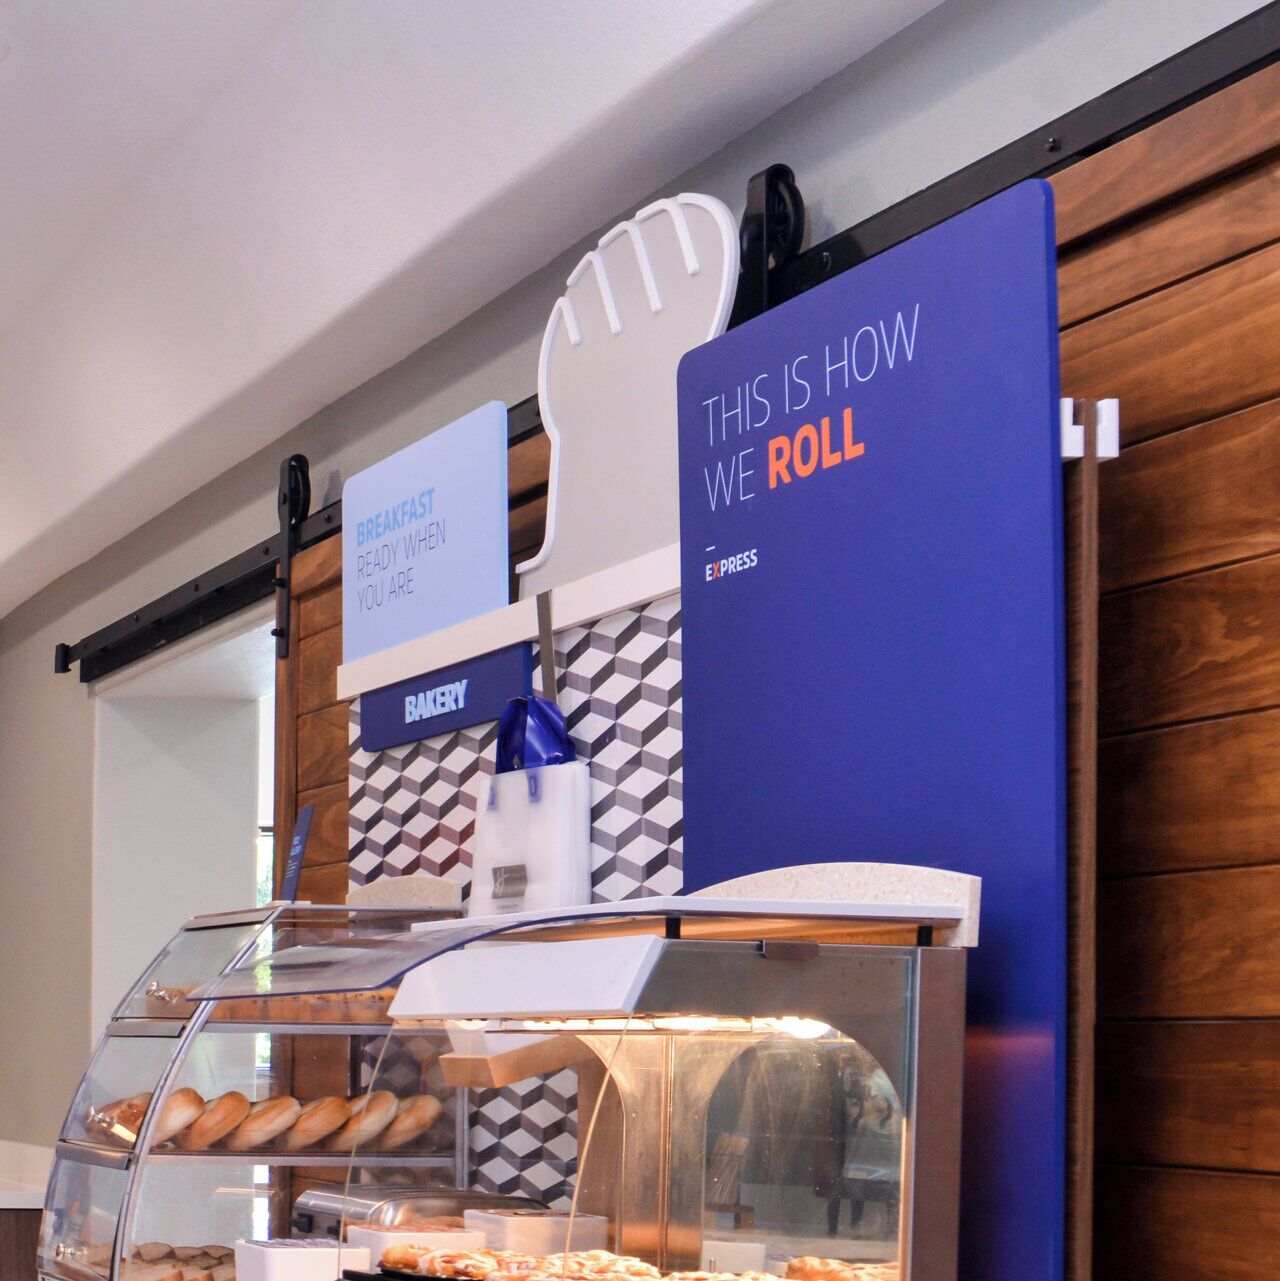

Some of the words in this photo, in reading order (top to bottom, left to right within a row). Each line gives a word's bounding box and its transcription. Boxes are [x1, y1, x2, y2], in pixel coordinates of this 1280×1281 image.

[703, 374, 770, 446] THIS
[785, 355, 811, 414] IS
[826, 303, 919, 396] HOW
[705, 448, 755, 511] WE
[768, 407, 865, 489] ROLL
[356, 487, 436, 547] BREAKFAST
[356, 540, 399, 581] READY
[403, 518, 447, 561] WHEN
[705, 549, 758, 581] EXPRESS
[356, 582, 384, 613] YOU
[389, 567, 415, 601] ARE
[405, 679, 468, 724] BAKERY
